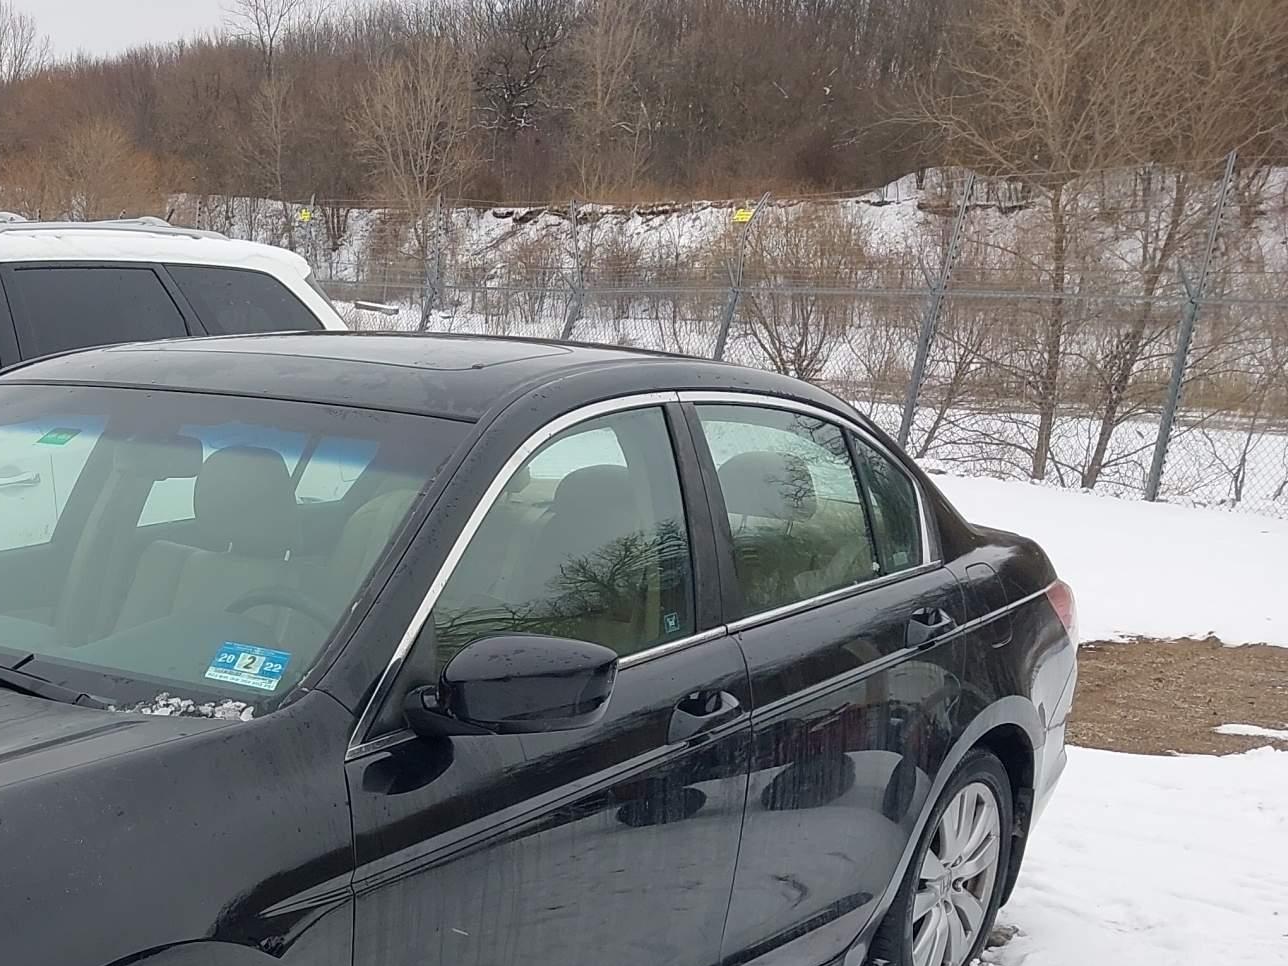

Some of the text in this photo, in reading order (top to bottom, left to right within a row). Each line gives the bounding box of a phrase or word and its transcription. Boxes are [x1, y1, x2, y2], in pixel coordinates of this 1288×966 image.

[218, 653, 283, 673] 20 2 22
